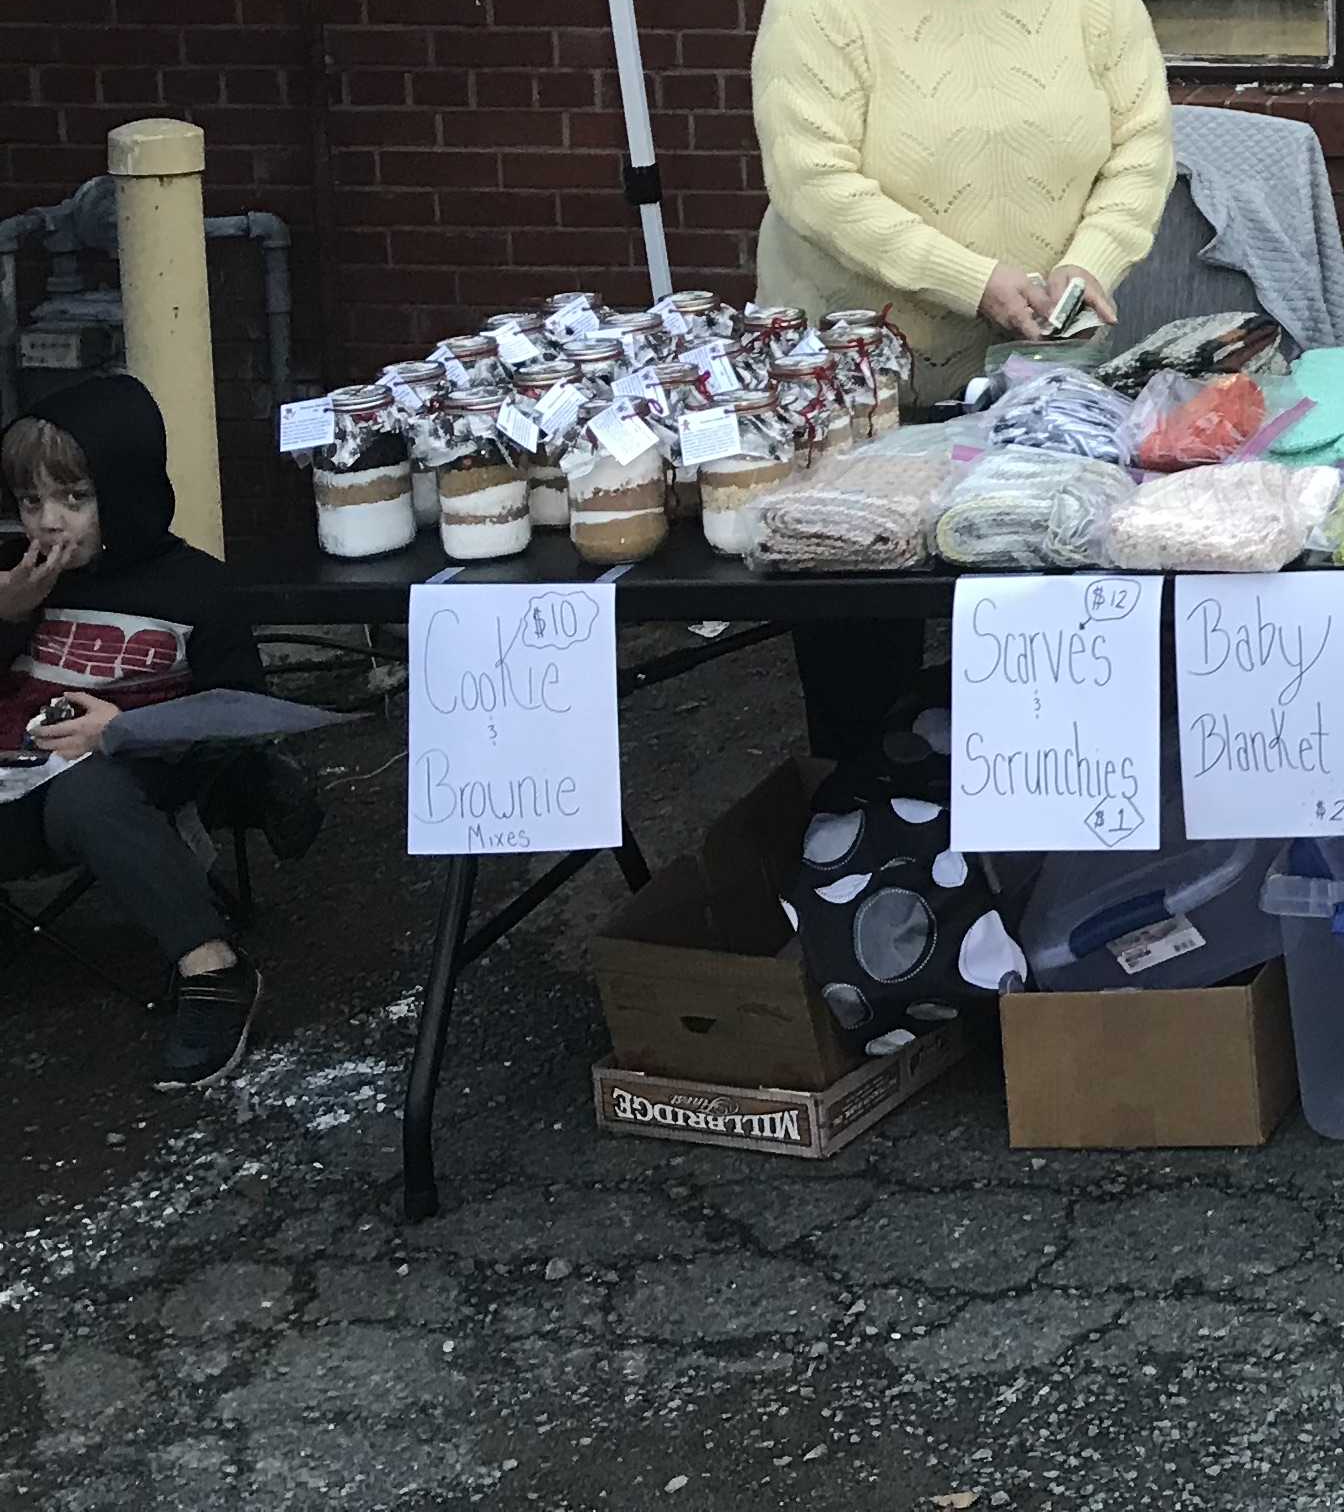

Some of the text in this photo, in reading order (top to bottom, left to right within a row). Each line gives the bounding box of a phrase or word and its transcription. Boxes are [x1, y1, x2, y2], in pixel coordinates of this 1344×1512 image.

[533, 599, 578, 638] $10
[1092, 587, 1129, 611] $12
[424, 608, 572, 714] Cookie
[964, 598, 1113, 687] Scarves
[1186, 595, 1332, 706] Baby
[960, 720, 1139, 799] Scrunchies
[1190, 701, 1331, 778] Blanket
[413, 748, 581, 824] Brownie
[1093, 808, 1133, 833] $1
[467, 824, 531, 852] Mixes
[612, 1087, 801, 1141] MILLBRIDGE
